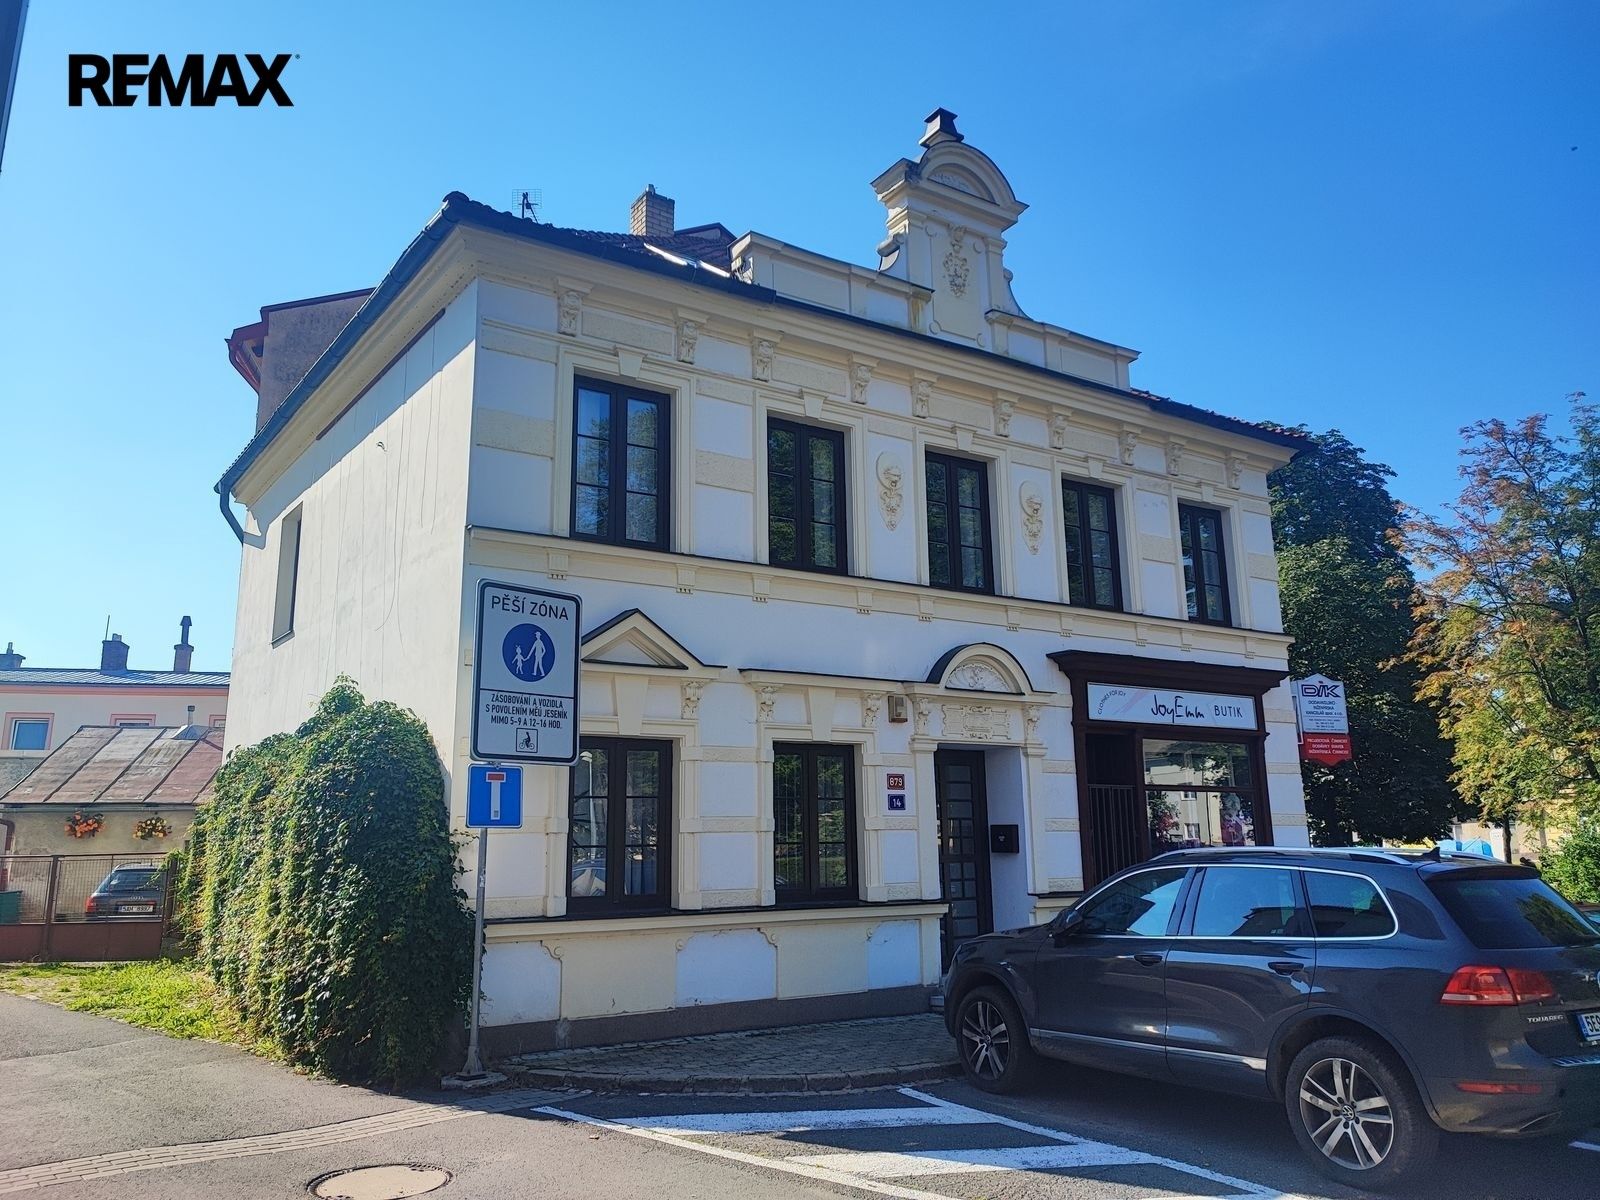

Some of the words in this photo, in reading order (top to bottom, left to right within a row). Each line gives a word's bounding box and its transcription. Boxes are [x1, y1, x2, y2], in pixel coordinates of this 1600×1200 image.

[491, 593, 526, 614] PĚŠÍ
[529, 600, 569, 621] ZÓNA
[491, 692, 531, 706] ZÁSOBOVÁNÍ
[532, 698, 537, 706] A
[539, 698, 564, 709] VOZIDLA
[485, 703, 490, 713] S
[491, 704, 527, 716] POVOLENÍM
[543, 708, 568, 719] JESENÍK
[1214, 704, 1243, 718] BUTIK
[491, 715, 509, 725] MIMO
[523, 718, 528, 726] A
[893, 798, 902, 807] 14
[1527, 1014, 1564, 1023] TOUAREG
